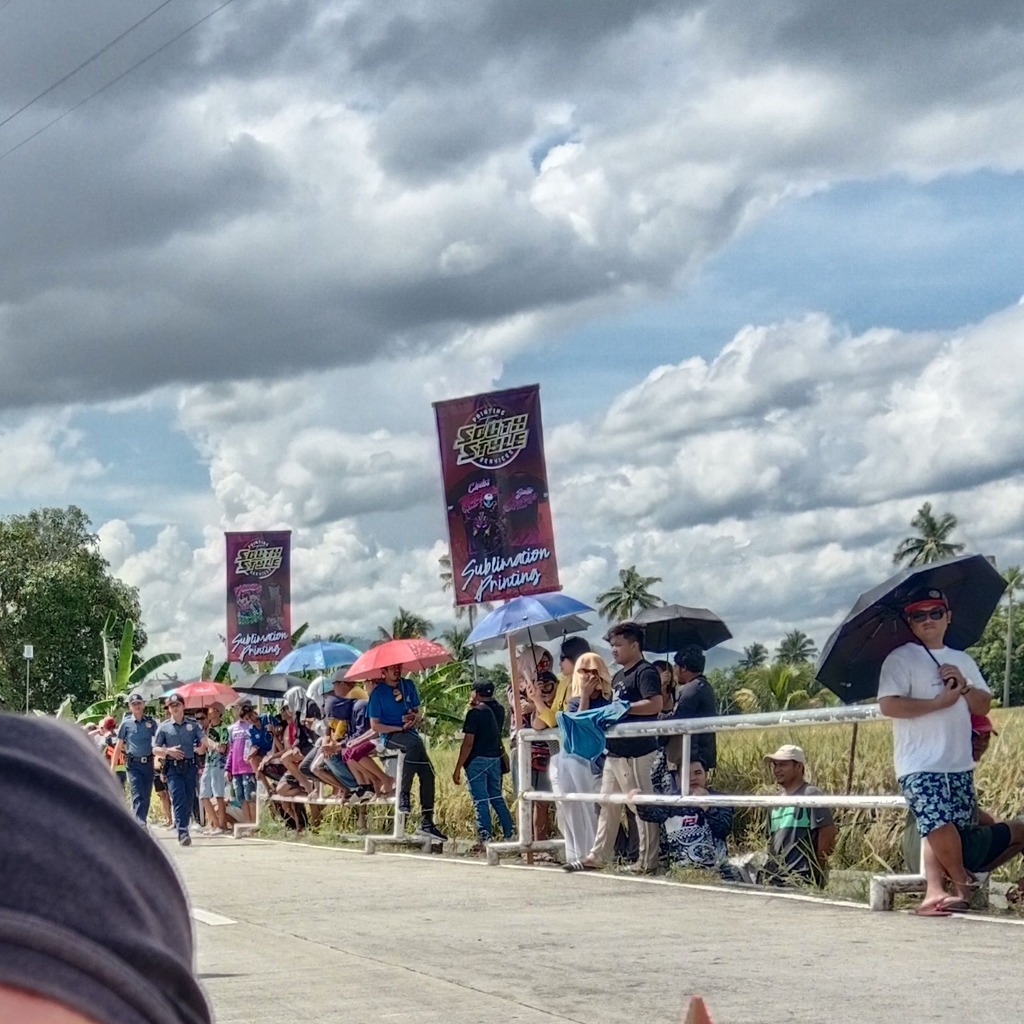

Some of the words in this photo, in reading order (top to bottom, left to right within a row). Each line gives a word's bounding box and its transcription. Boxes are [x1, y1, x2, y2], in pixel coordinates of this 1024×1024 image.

[472, 407, 506, 423] PRINTING
[455, 414, 528, 447] SOUTH
[458, 431, 528, 463] STYLE
[236, 558, 281, 574] STYLE
[461, 547, 550, 591] Sublimation
[474, 568, 541, 602] Printing
[231, 631, 288, 652] Sublimation
[238, 644, 281, 662] Printing
